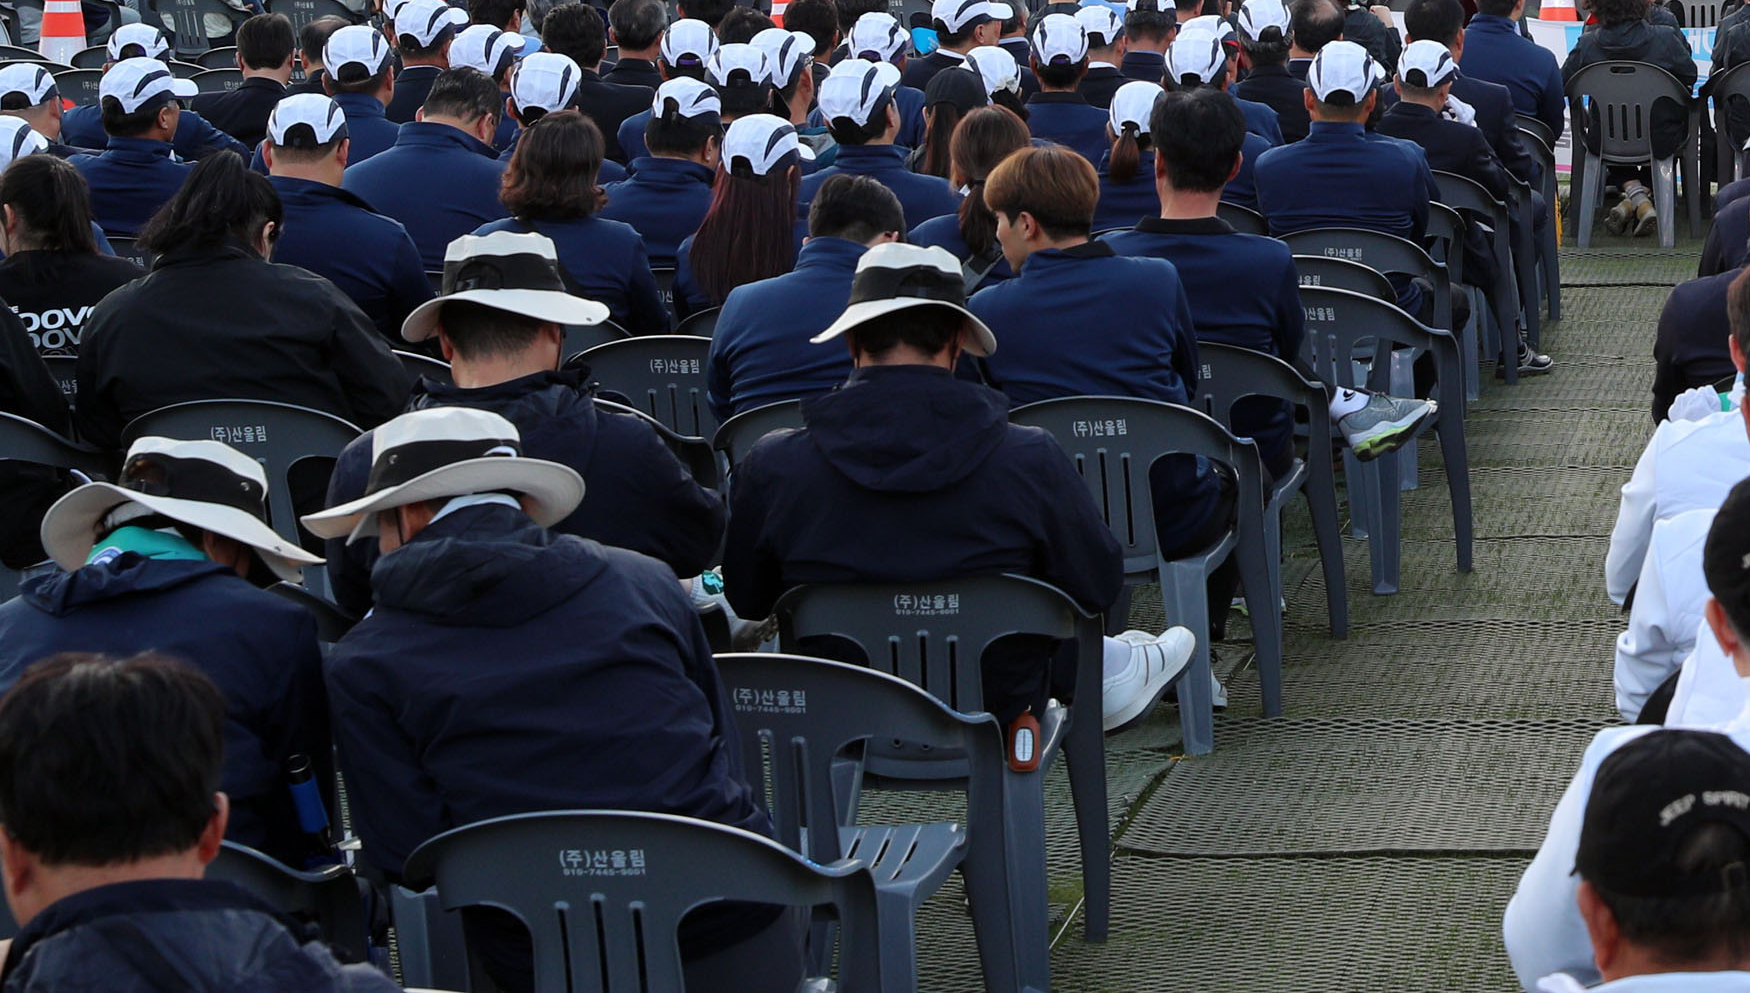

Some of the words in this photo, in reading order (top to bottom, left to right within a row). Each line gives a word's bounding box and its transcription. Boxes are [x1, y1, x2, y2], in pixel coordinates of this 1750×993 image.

[1324, 248, 1362, 258] (주)산울림
[650, 359, 700, 375] (주)산울림
[210, 425, 267, 443] (주)산울림
[1073, 418, 1127, 437] (주)산울림
[894, 593, 959, 609] (주)산울림
[733, 687, 806, 706] (주)산울림
[1659, 793, 1696, 827] JEEP
[559, 849, 645, 868] (주)산울림
